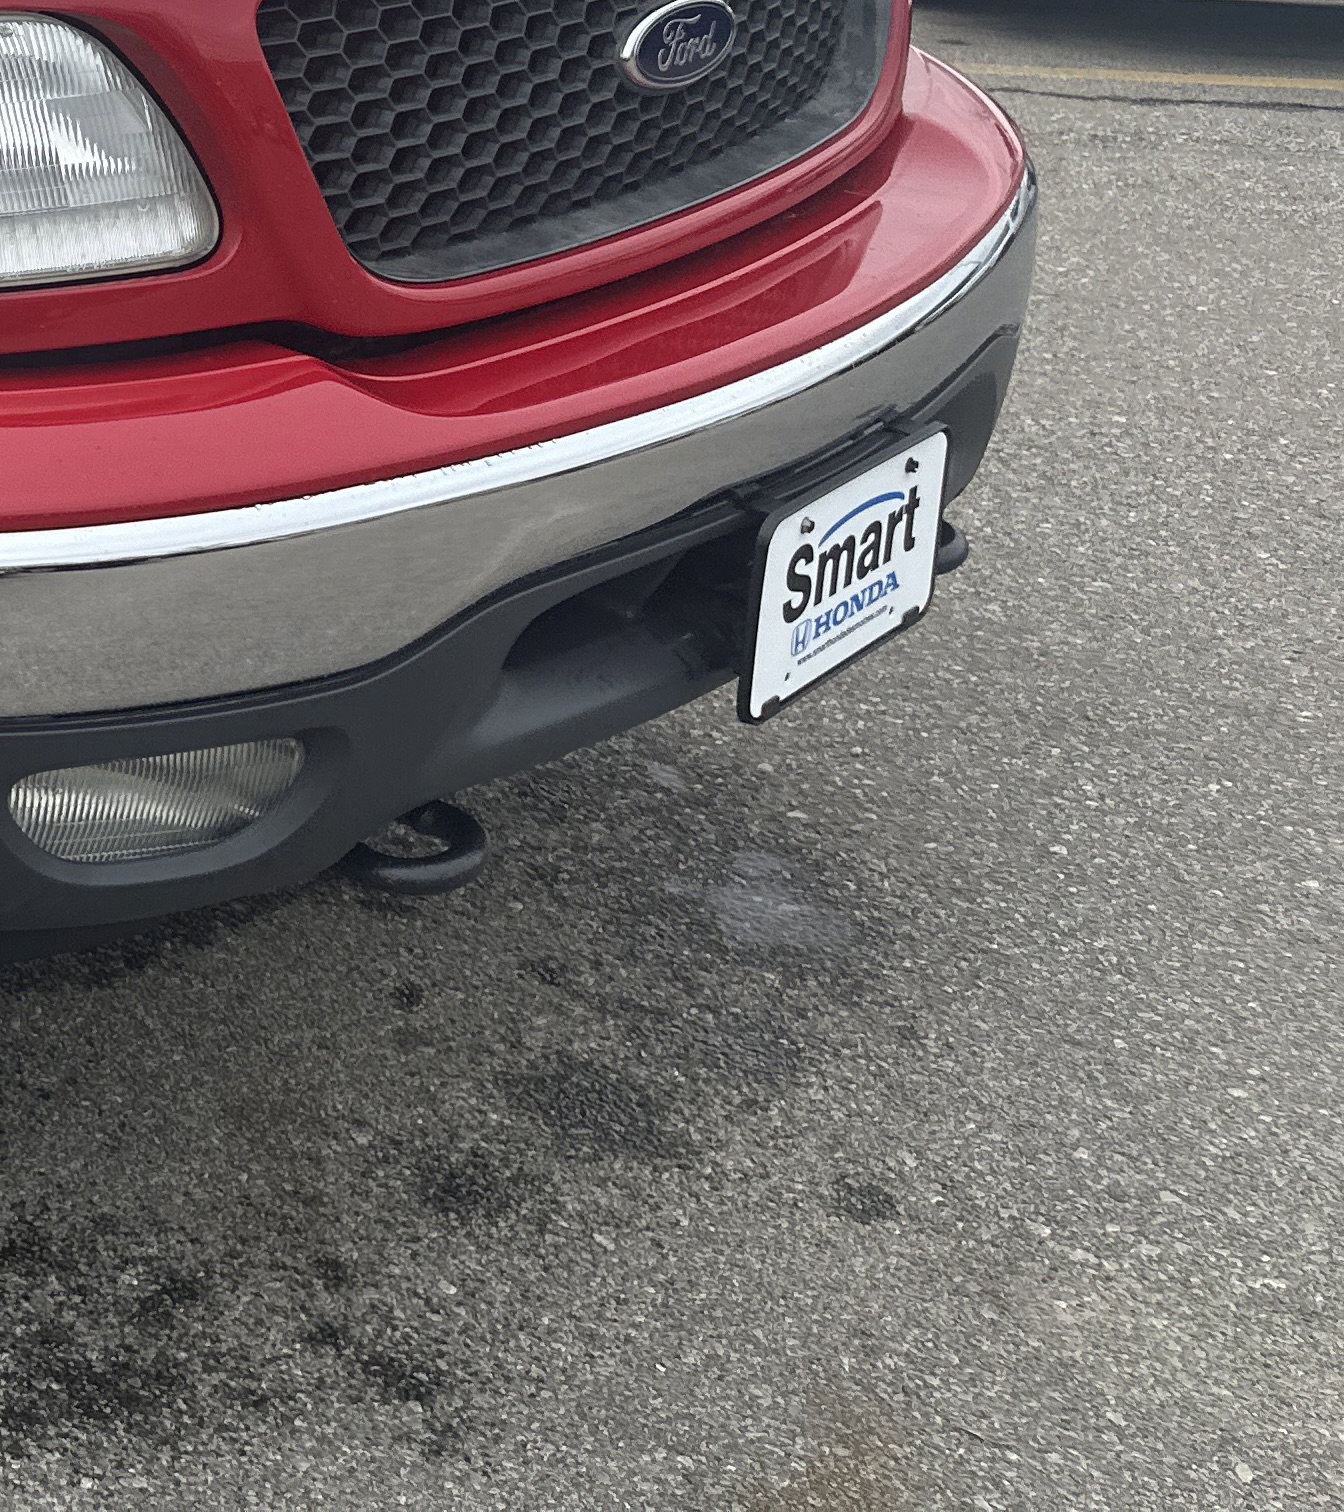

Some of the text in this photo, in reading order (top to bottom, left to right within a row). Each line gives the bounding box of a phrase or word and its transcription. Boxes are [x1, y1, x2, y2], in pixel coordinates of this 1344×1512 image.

[657, 13, 717, 72] Ford
[782, 485, 921, 624] Smart
[812, 570, 901, 640] HONDA
